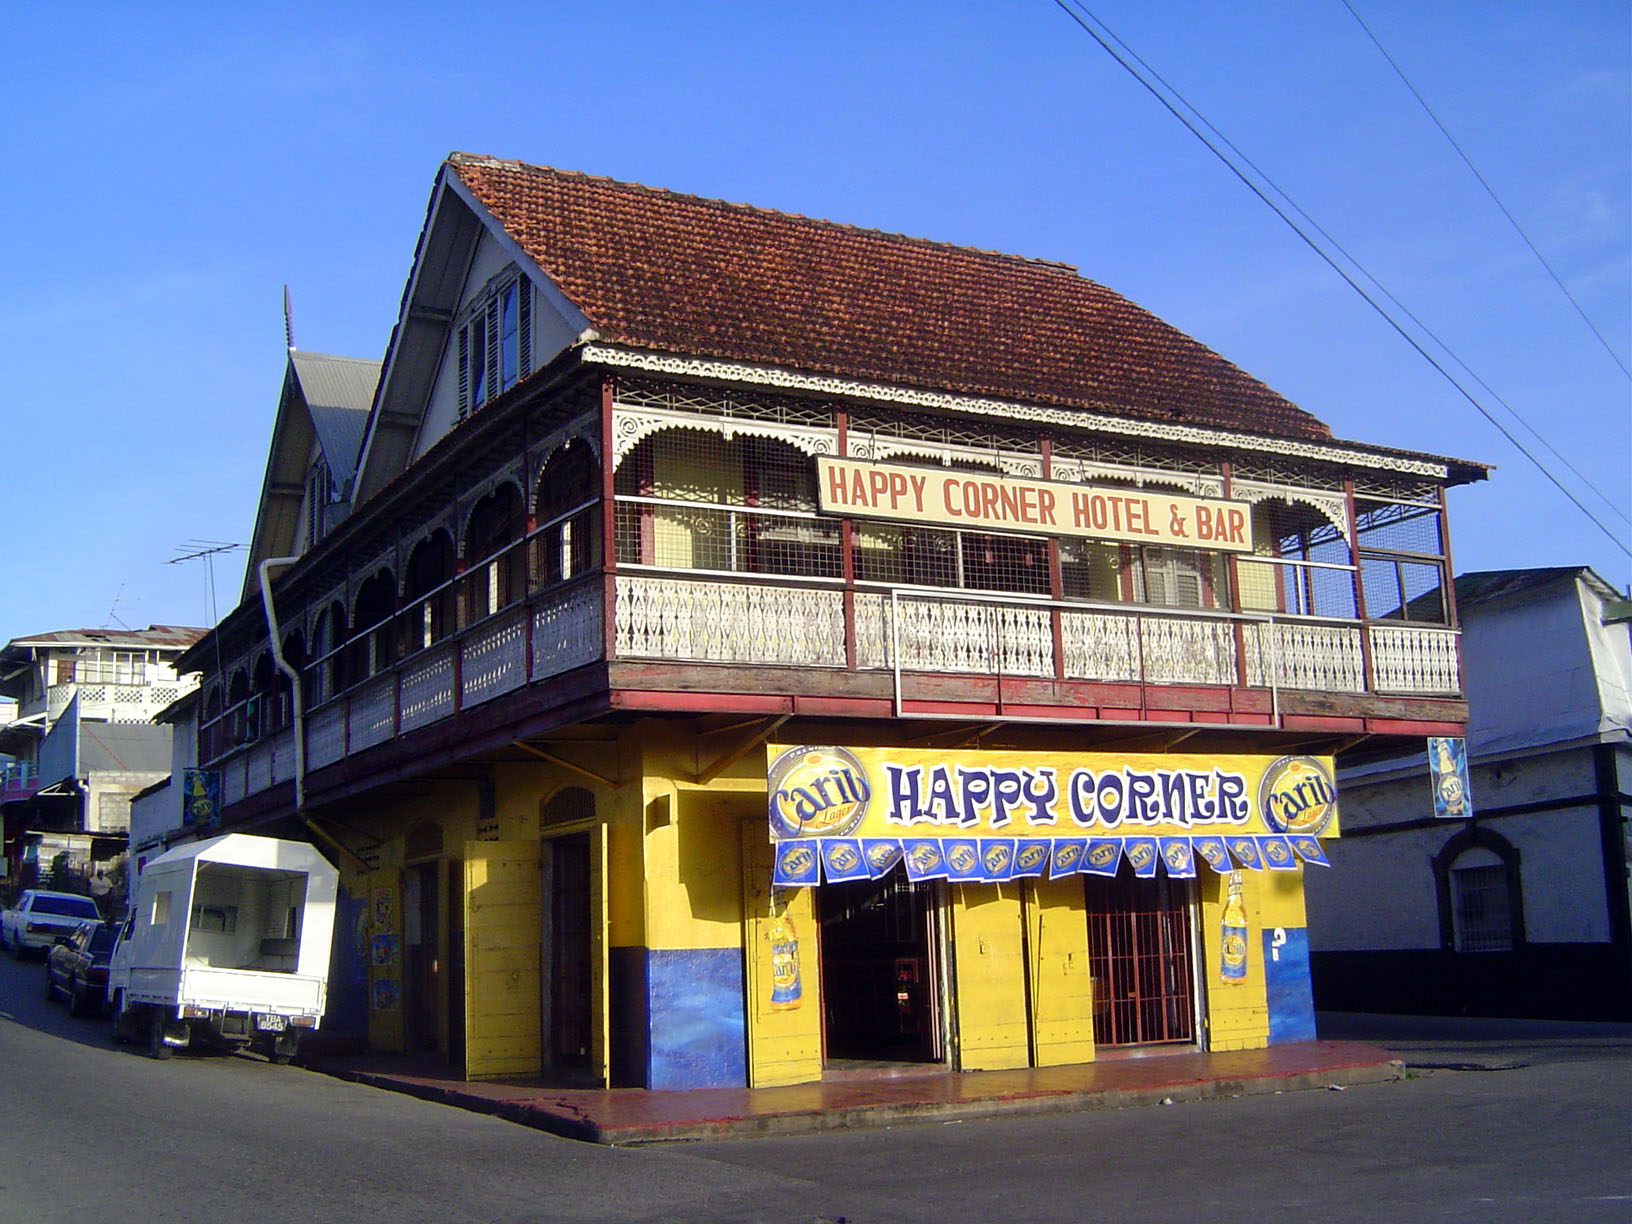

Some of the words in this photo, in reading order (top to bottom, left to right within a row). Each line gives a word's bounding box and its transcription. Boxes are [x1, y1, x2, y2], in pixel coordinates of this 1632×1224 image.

[828, 465, 926, 512] HAPPY
[943, 478, 1057, 526] CORNER
[1072, 492, 1160, 536] HOTEL
[1169, 503, 1190, 539] &
[1196, 505, 1245, 544] BAR
[885, 764, 1057, 826] HAPPY
[1068, 767, 1250, 827] CORNER
